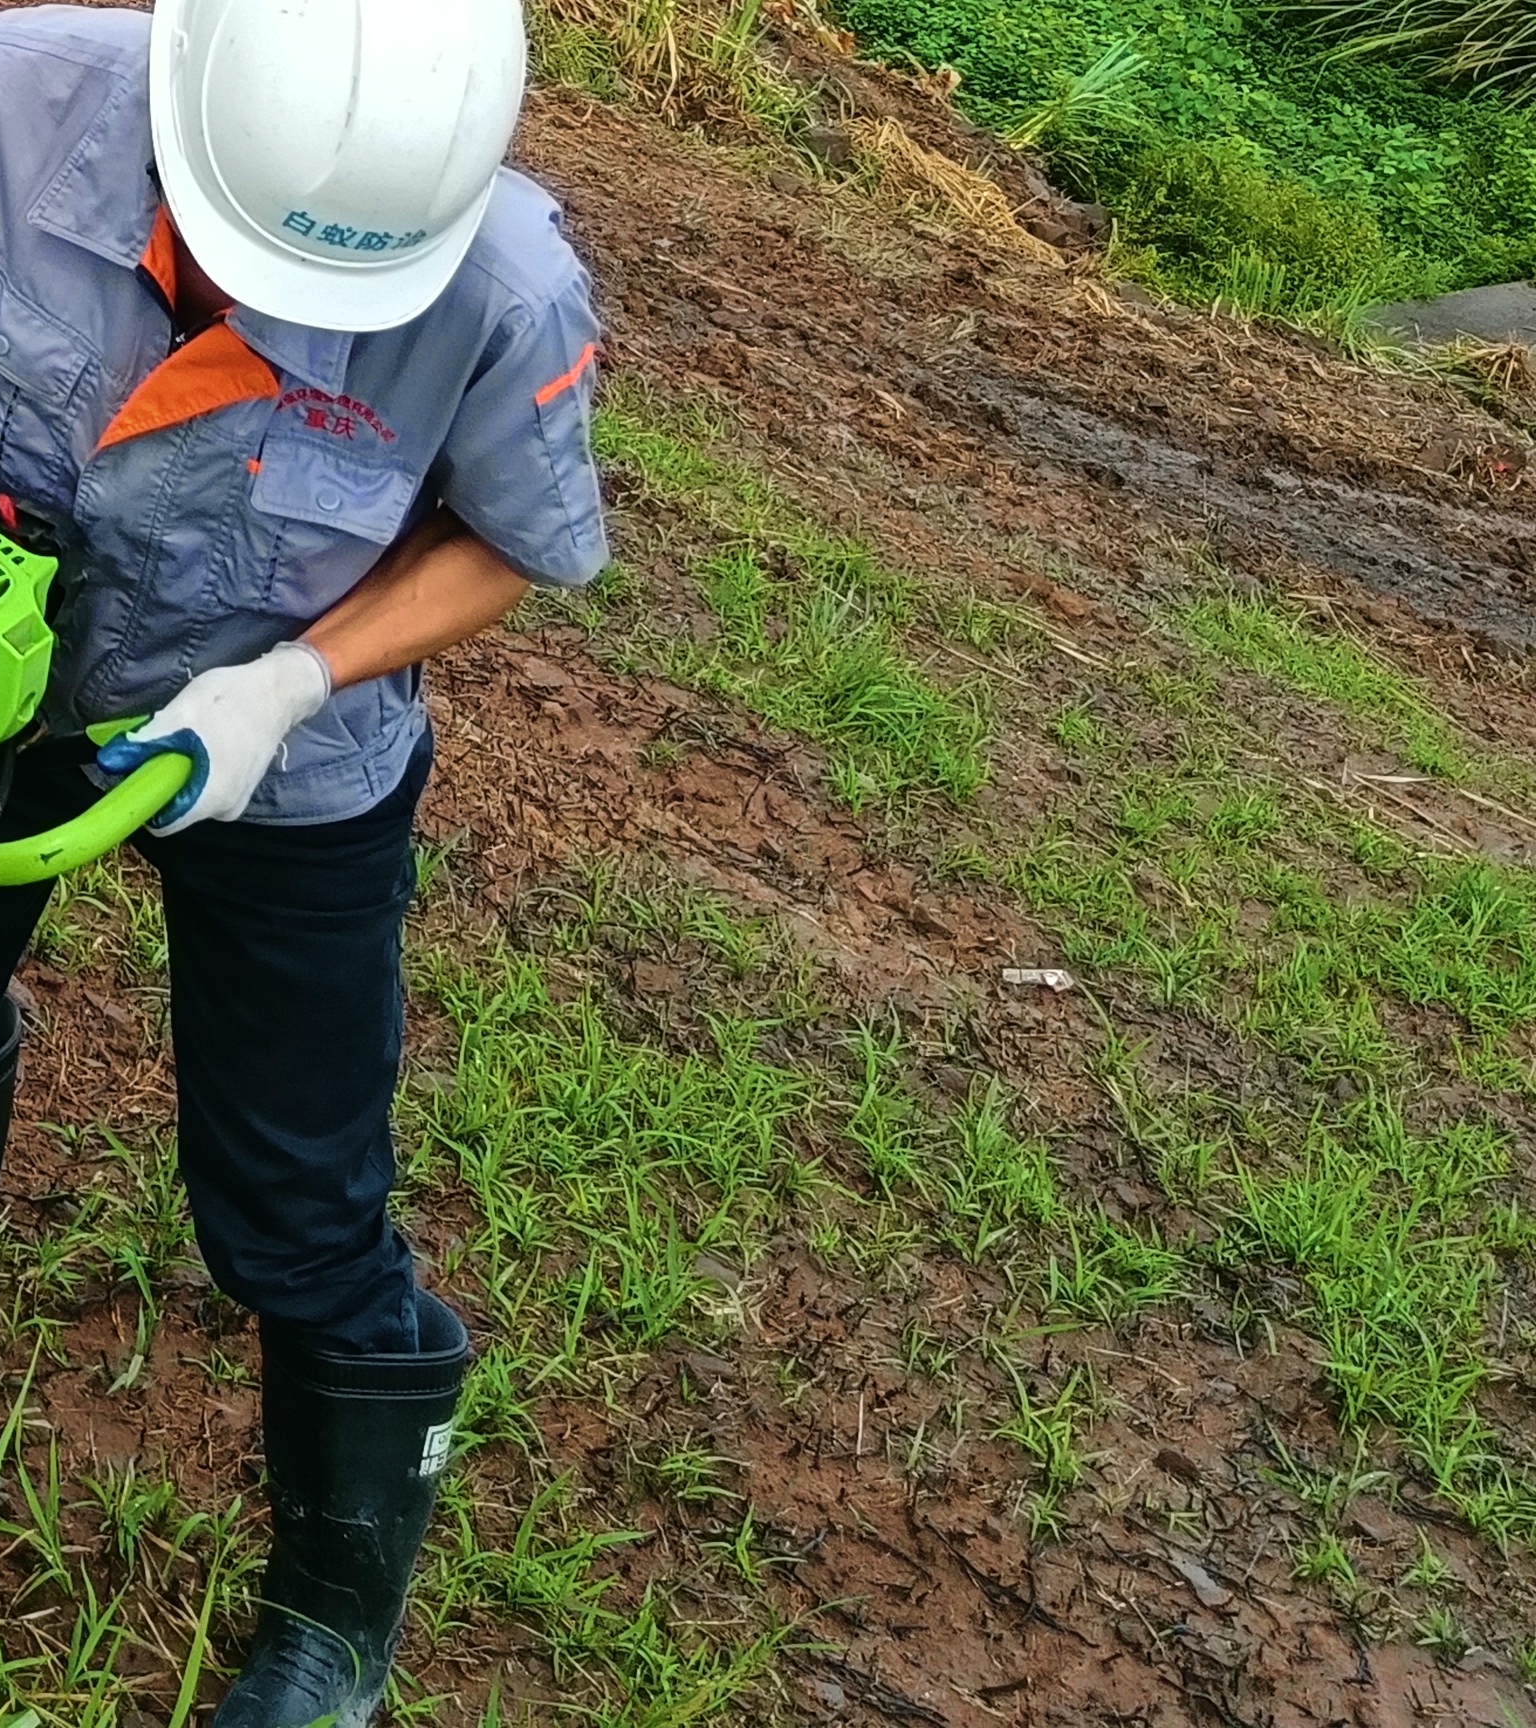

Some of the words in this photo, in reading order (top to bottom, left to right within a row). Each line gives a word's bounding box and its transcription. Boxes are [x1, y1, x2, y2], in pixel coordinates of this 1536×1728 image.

[282, 210, 427, 251] 白蚁防治
[304, 407, 356, 441] 重庆
